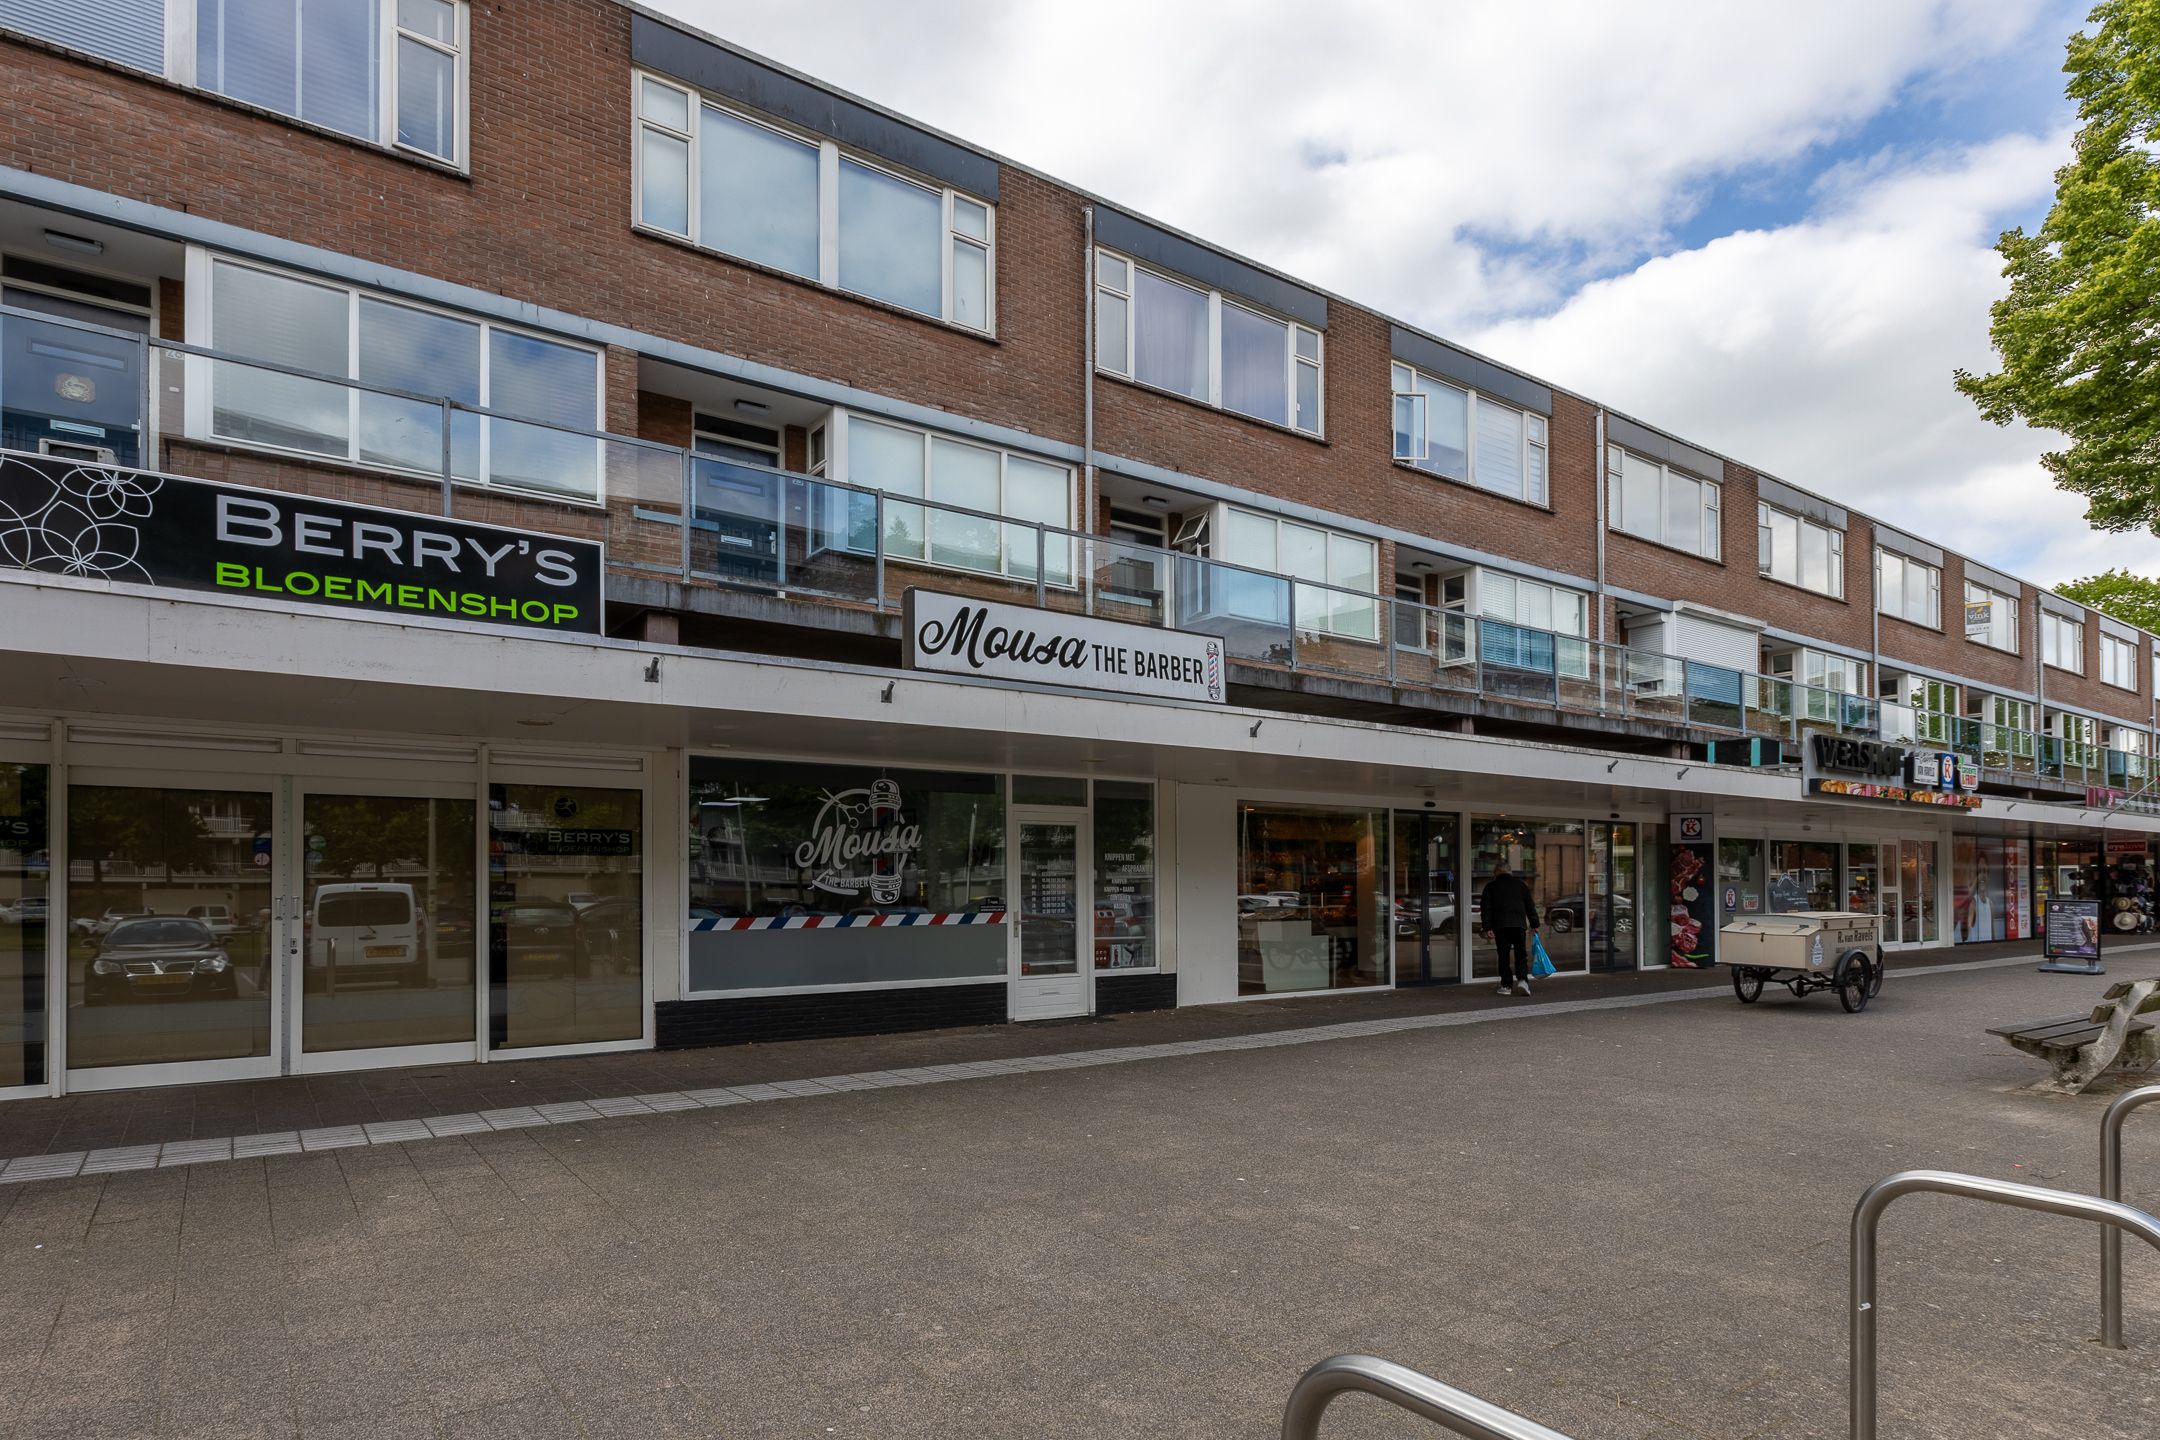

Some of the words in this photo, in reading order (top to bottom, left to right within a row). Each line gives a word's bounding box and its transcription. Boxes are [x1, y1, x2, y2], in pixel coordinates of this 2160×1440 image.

[216, 494, 578, 588] BERRY'S
[216, 562, 579, 624] BLOEMENSHOP
[918, 606, 1088, 669] Mousa
[1092, 643, 1127, 675] THE
[1134, 650, 1204, 685] BARBER
[1813, 734, 1905, 777] VERSHOF
[548, 830, 631, 844] BERRY'S
[795, 824, 922, 870] Mousa
[824, 876, 839, 887] THE
[840, 878, 869, 889] BARBER
